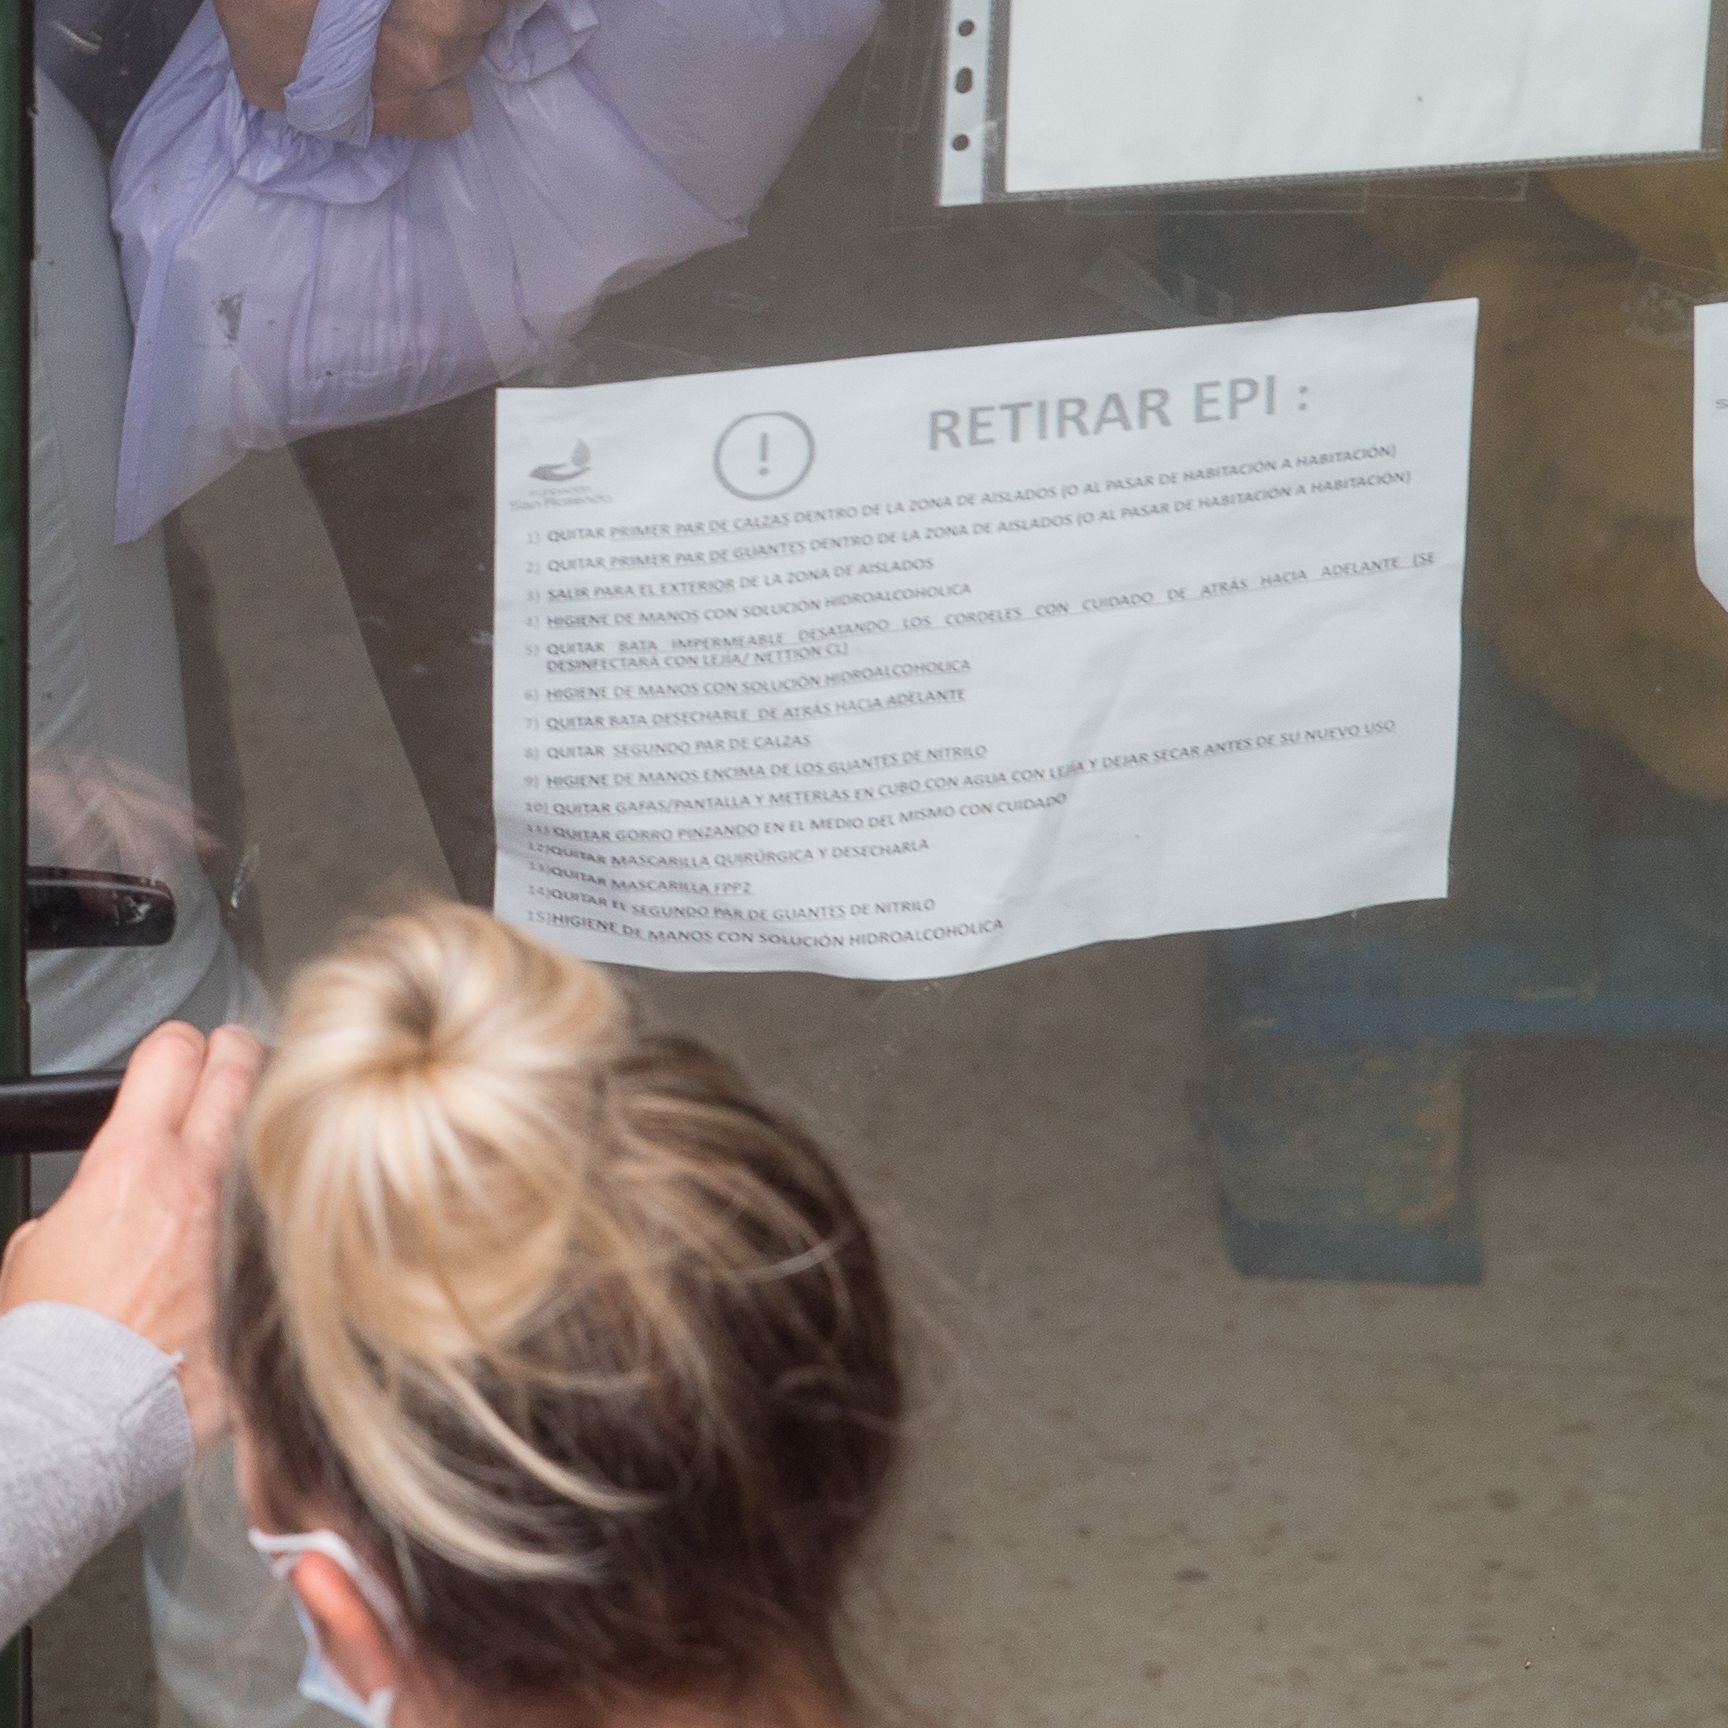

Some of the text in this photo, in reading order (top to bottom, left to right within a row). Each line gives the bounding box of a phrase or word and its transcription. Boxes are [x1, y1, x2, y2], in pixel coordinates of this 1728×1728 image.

[928, 388, 1172, 451] RETIRAR
[1195, 374, 1276, 423] EPI
[547, 528, 605, 543] QUITAR
[610, 524, 670, 540] PRIMER
[676, 522, 703, 535] PAR
[709, 520, 729, 532] DE
[733, 515, 790, 531] CALZAS
[795, 507, 857, 523] DENTRO
[862, 504, 882, 516] DE
[886, 503, 905, 514] LA
[909, 496, 952, 512] ZONA
[957, 495, 976, 507] DE
[981, 486, 1057, 504] AISLADOS
[1061, 483, 1079, 499] (O
[1084, 482, 1101, 495] AL
[1106, 474, 1154, 492] PASAR
[1159, 472, 1178, 484] DE
[1183, 458, 1277, 482] HABITACIÓN
[1281, 458, 1292, 469] A
[1296, 444, 1397, 468] HABITACIÓN)
[547, 587, 589, 601] SALIR
[594, 585, 635, 598] PARA
[640, 584, 655, 595] EL
[661, 578, 735, 594] EXTERIOR
[740, 576, 757, 588] DE
[764, 574, 782, 585] LA
[786, 567, 829, 583] ZONA
[834, 565, 854, 577] DE
[858, 556, 934, 575] AISLADOS
[547, 613, 608, 629] HIGIENE
[614, 612, 634, 624] DE
[639, 609, 699, 623] MANOS
[704, 607, 735, 620] CON
[742, 598, 821, 618] SOLUCIÓN
[825, 582, 972, 607] HIDROALCOHOLICA
[546, 715, 605, 730] QUITAR
[610, 715, 648, 727] BATA
[652, 708, 748, 725] DESECHABLE
[757, 707, 778, 719] DE
[783, 702, 831, 718] ATRÁS
[835, 698, 882, 713] HACIA
[887, 688, 966, 708] ADELANTE
[546, 745, 605, 759] QUITAR
[613, 741, 691, 757] SEGUNDO
[695, 739, 724, 752] PAR
[729, 737, 749, 749] DE
[754, 734, 811, 748] CALZAS
